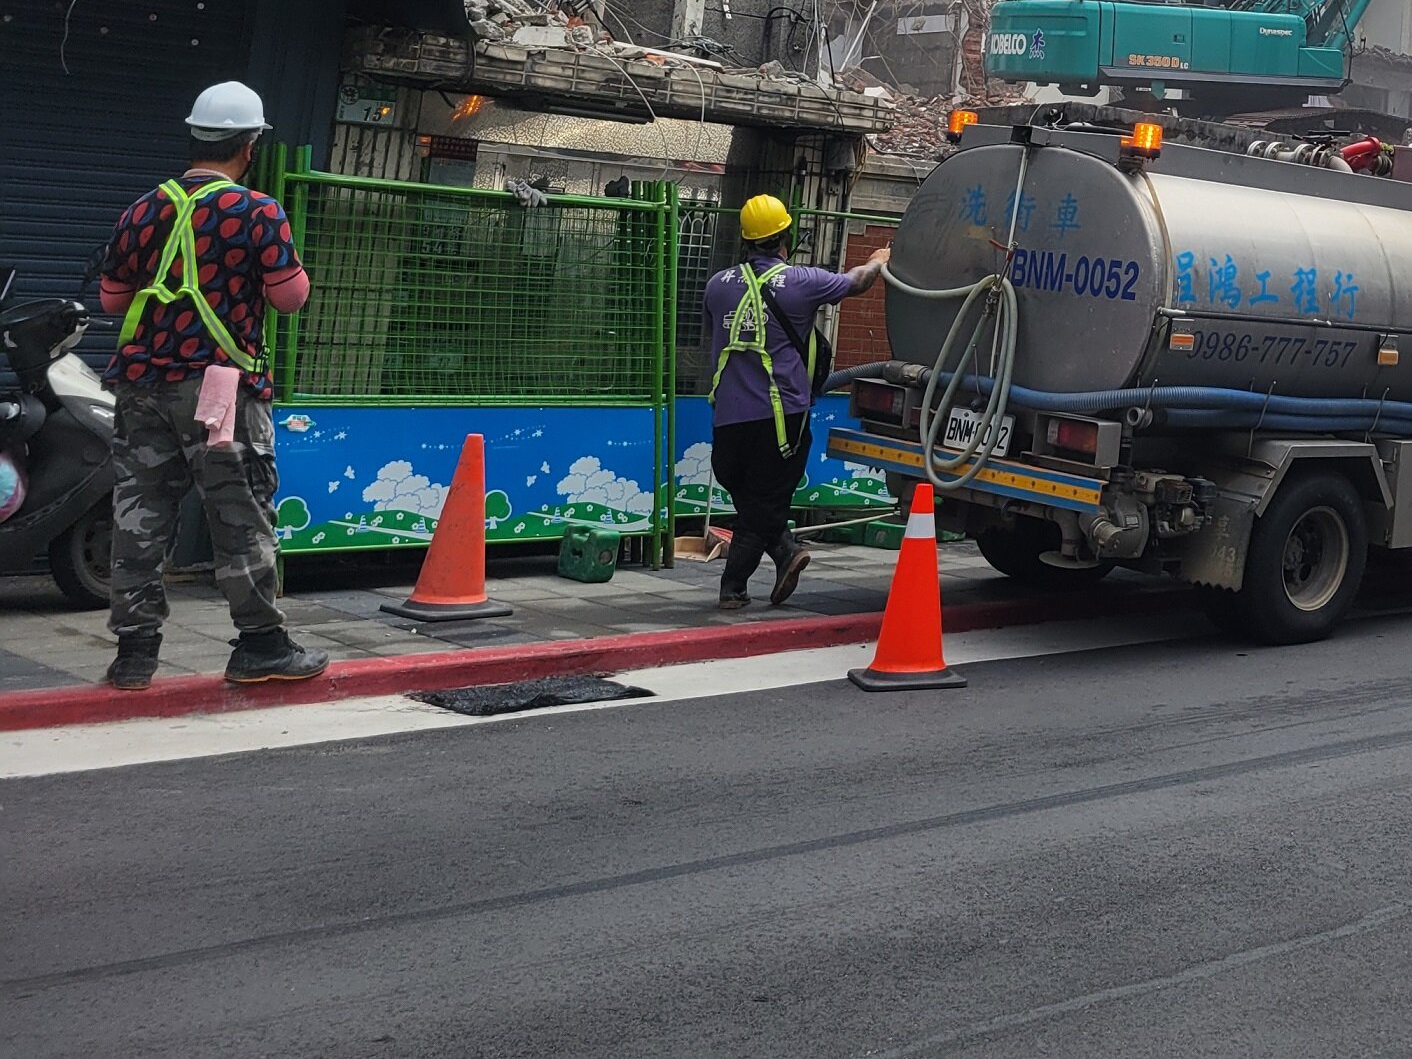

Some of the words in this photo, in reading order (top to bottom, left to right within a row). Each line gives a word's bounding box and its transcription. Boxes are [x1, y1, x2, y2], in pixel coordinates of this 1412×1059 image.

[1259, 26, 1293, 37] Dynaspec
[1012, 248, 1140, 301] BNM-0052
[1176, 250, 1360, 320] 呈鴻工程行
